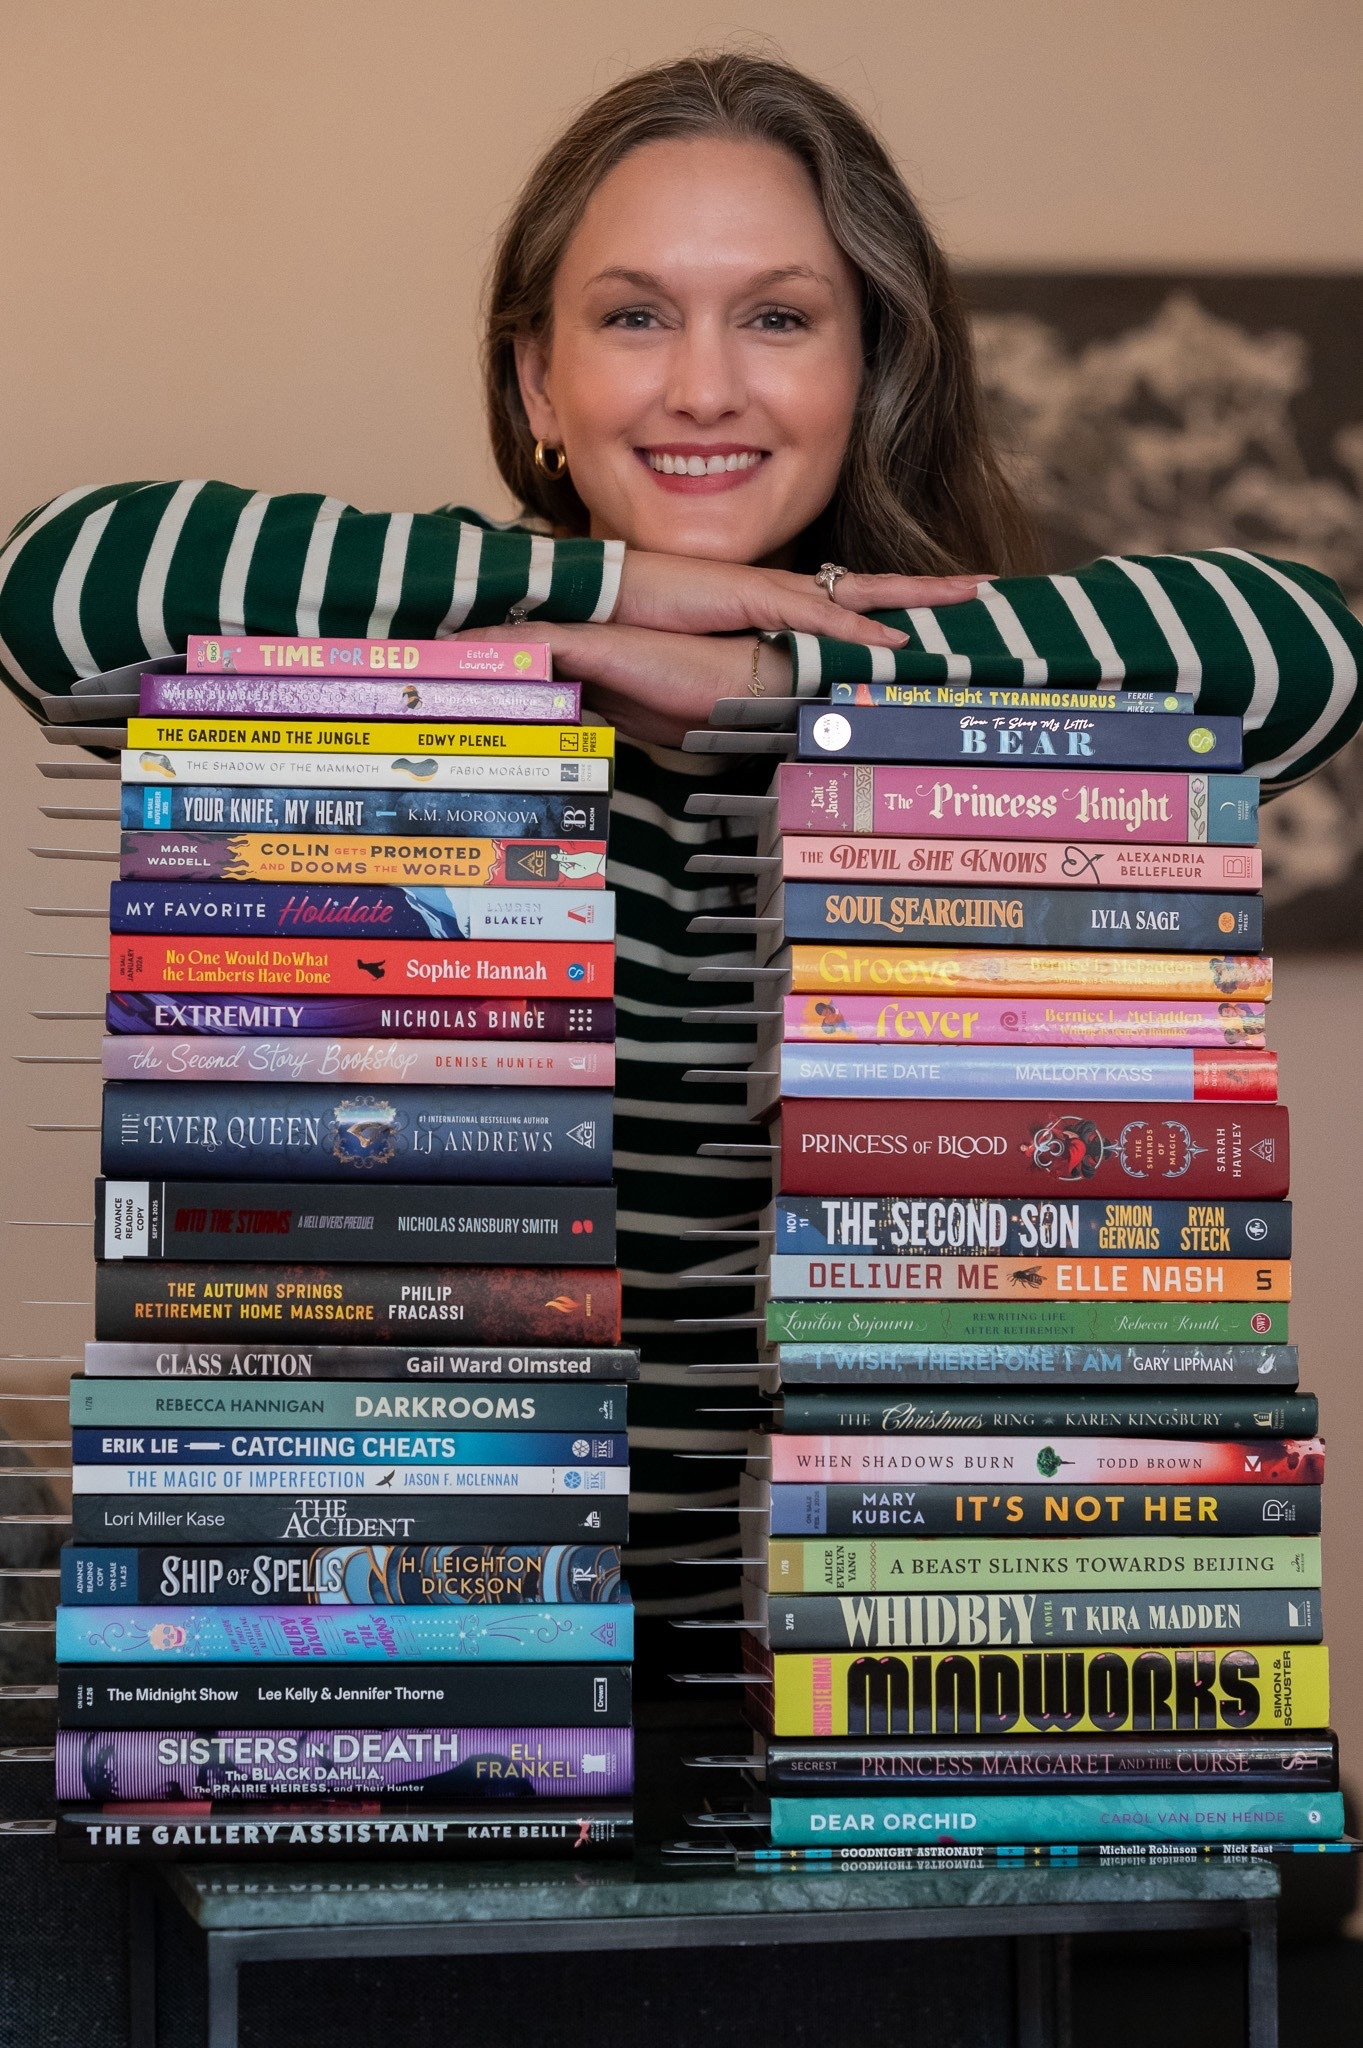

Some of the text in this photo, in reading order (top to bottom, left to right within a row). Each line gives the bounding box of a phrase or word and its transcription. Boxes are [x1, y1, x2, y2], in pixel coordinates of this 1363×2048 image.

[260, 645, 324, 667] TIME
[370, 646, 420, 670] BED
[467, 648, 498, 659] Estrela
[886, 686, 1116, 709] Night Night TYRANNOSAURUS
[1128, 692, 1153, 700] FERRIE
[1127, 705, 1154, 713] MIKECZ
[157, 728, 370, 746] THE GARDEN AND THE JUNGLE
[960, 729, 1095, 756] BEAR
[450, 766, 550, 777] FABIO MORÁBITO
[184, 798, 363, 826] YOUR KNIFE, MY HEART
[884, 781, 1172, 832] The Princess Knight
[161, 845, 198, 853] MARK
[261, 844, 480, 859] COLIN GETS PROMOTED
[1117, 852, 1205, 864] ALEXANDRIA
[148, 857, 210, 866] WADDELL
[801, 845, 1047, 873] THE DEVIL SHE KNOWS
[1121, 865, 1202, 878] BELLEFLEUR
[126, 902, 266, 918] MY FAVORITE
[826, 895, 1024, 932] SOUL SEARCHING
[485, 916, 543, 925] BLAKELY
[1092, 910, 1179, 930] LYLA SAGE
[406, 959, 547, 982] Sophie Hannah
[155, 1006, 304, 1027] EXTREMITY
[382, 1010, 544, 1028] NICHOLAS BINGE
[877, 1003, 980, 1038] fever
[436, 1056, 554, 1068] DENISE HUNTER
[144, 1116, 320, 1152] EVER QUEEN
[414, 1132, 552, 1154] LJ ANDREWS
[802, 1134, 1007, 1158] PRINCESS OF BLOOD
[1159, 1143, 1164, 1155] OF
[1217, 1128, 1225, 1172] SARAH
[1233, 1123, 1241, 1178] HAWLEY
[114, 1198, 122, 1240] ADVANCE
[398, 1217, 558, 1234] NICHOLAS SANSBURY SMITH
[822, 1201, 1079, 1249] THE SECOND SON
[1189, 1206, 1224, 1227] RYAN
[1180, 1228, 1230, 1251] STECK
[809, 1263, 999, 1290] DELIVER ME
[1056, 1265, 1224, 1293] ELLE NASH
[401, 1286, 452, 1300] PHILIP
[389, 1305, 464, 1320] FRACASSI
[1257, 1315, 1265, 1332] SWP
[156, 1354, 312, 1376] CLASS ACTION
[407, 1357, 590, 1373] Gail Ward Olmsted
[1133, 1357, 1233, 1372] GARY LIPPMAN
[156, 1399, 324, 1413] REBECCA HANNIGAN
[355, 1397, 536, 1419] DARKROOMS
[1066, 1413, 1222, 1426] KAREN KINGSBURY
[232, 1436, 456, 1458] CATCHING CHEATS
[404, 1473, 518, 1486] JASON F. MCLENNAN
[956, 1496, 1218, 1522] IT'S NOT HER
[104, 1512, 225, 1526] Lori Miller Kase
[824, 1549, 833, 1585] ALICE
[836, 1545, 845, 1589] EVELYN
[848, 1552, 857, 1582] YANG
[890, 1557, 1274, 1574] A BEAST SLINKS TOWARDS BEIJING
[422, 1578, 522, 1594] DICKSON
[786, 1613, 794, 1630] 3/26
[838, 1594, 1036, 1647] WHIDBEY
[1062, 1604, 1240, 1635] T KIRA MADDEN
[1274, 1659, 1281, 1669] &
[107, 1688, 238, 1703] The Midnight Show
[1284, 1651, 1292, 1727] SCHUSTER
[158, 1734, 458, 1765] SISTERS IN DEATH
[512, 1744, 542, 1760] ELI
[476, 1762, 577, 1778] FRANKEL
[862, 1754, 1114, 1776] PRINCESS MARGARET
[811, 1813, 976, 1831] DEAR ORCHID
[86, 1823, 448, 1845] THE GALLERY ASSISTANT
[468, 1825, 566, 1839] KATE BELLI
[841, 1847, 984, 1858] GOODNIGHT ASTRONAUT
[1100, 1845, 1197, 1855] Michelle Robinson
